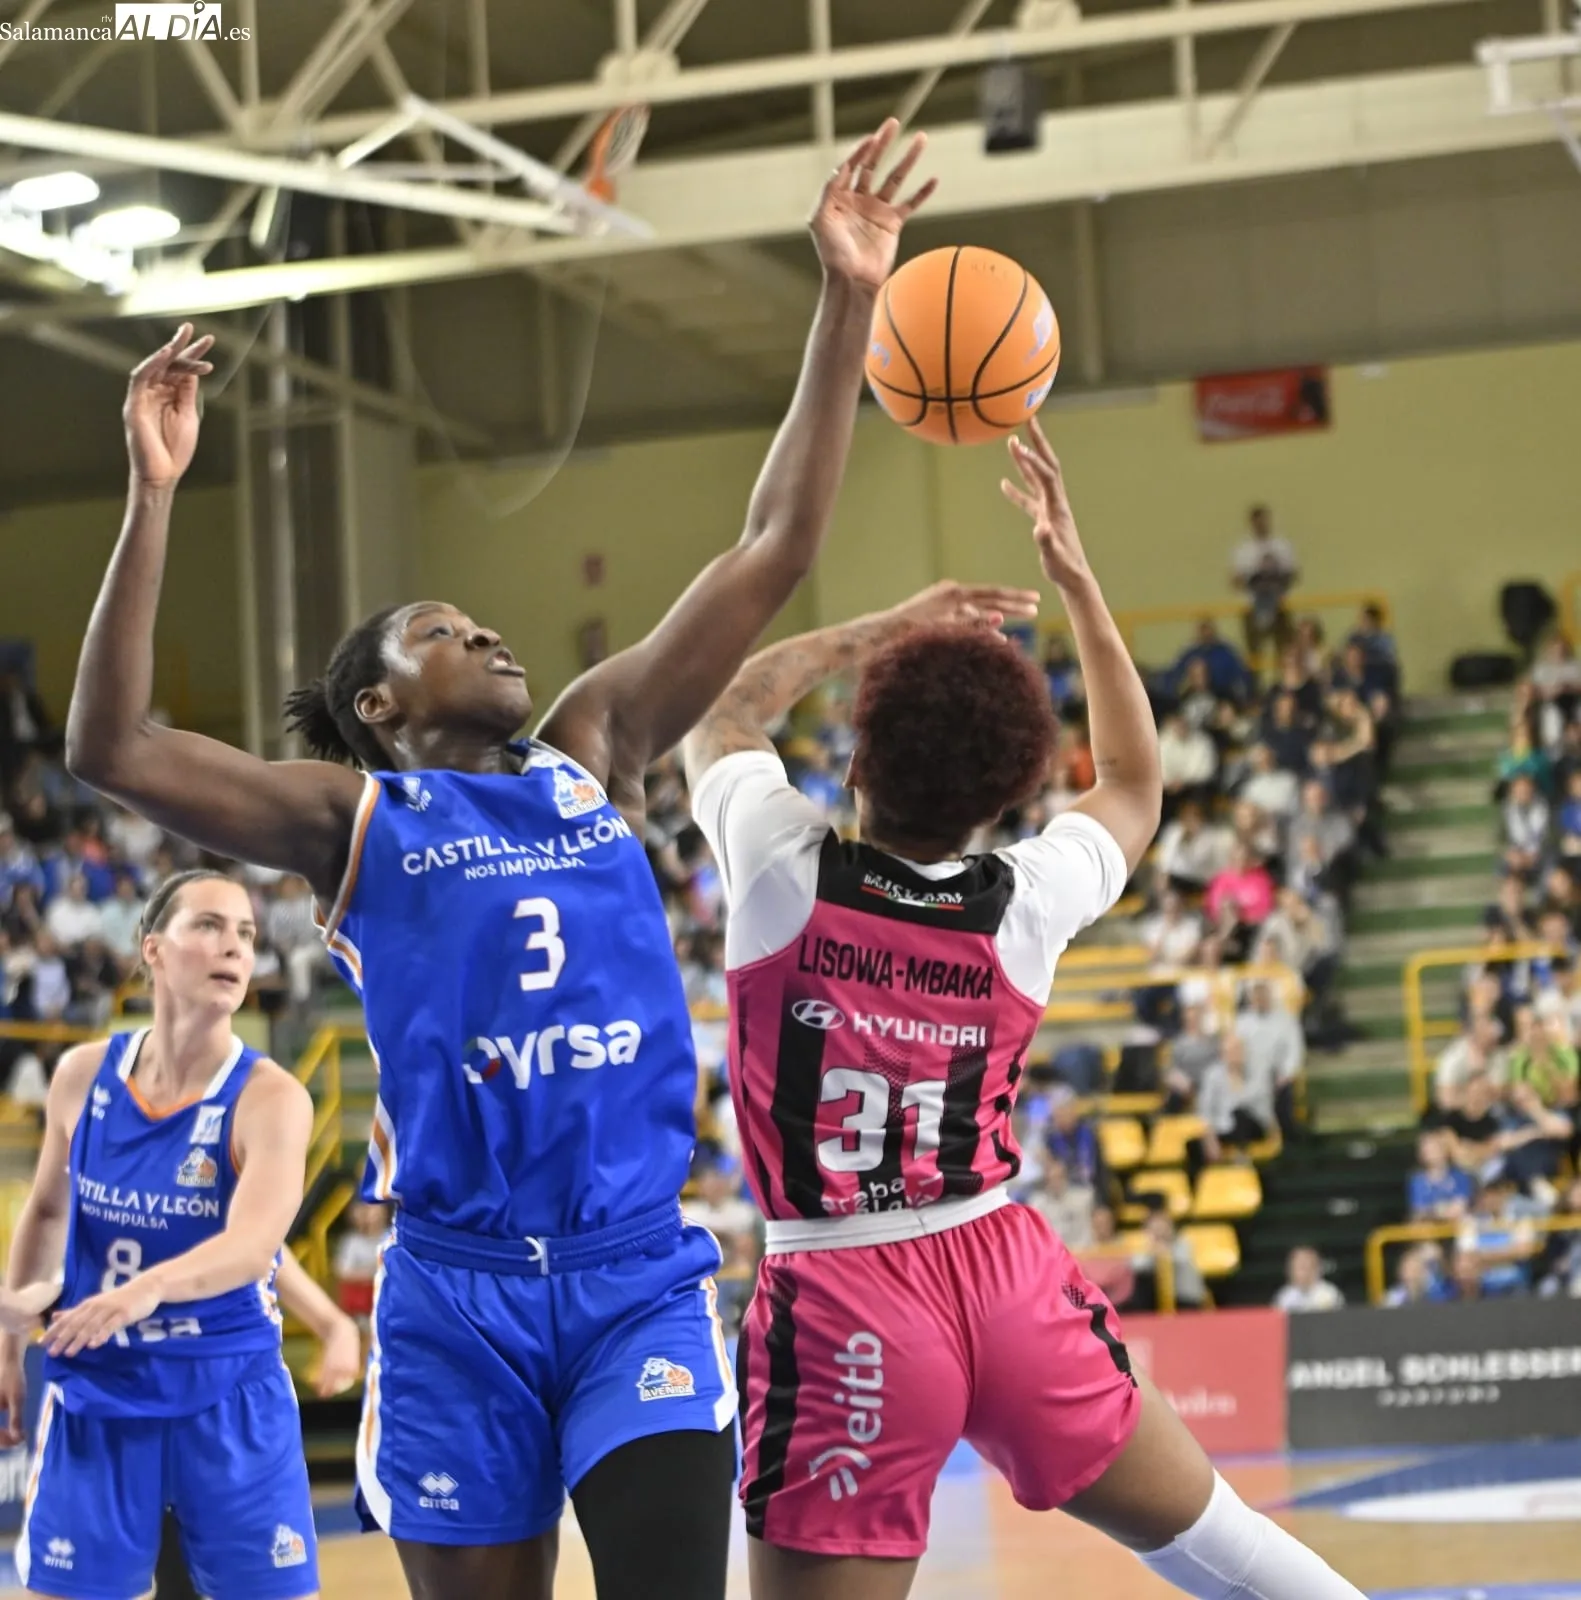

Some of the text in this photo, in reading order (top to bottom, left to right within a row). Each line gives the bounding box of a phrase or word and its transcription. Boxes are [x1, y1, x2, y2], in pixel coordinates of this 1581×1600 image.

[464, 862, 498, 881] NOS
[512, 896, 566, 992] 3
[797, 934, 995, 1000] LISOWA-MBAKA
[853, 1011, 987, 1047] HYUNDAI
[817, 1067, 947, 1173] 31
[103, 1209, 169, 1230] IMPULSA
[145, 1192, 161, 1214] Y
[161, 1193, 219, 1217] LEÓN
[102, 1239, 142, 1291] 8
[834, 1331, 884, 1443] eitb
